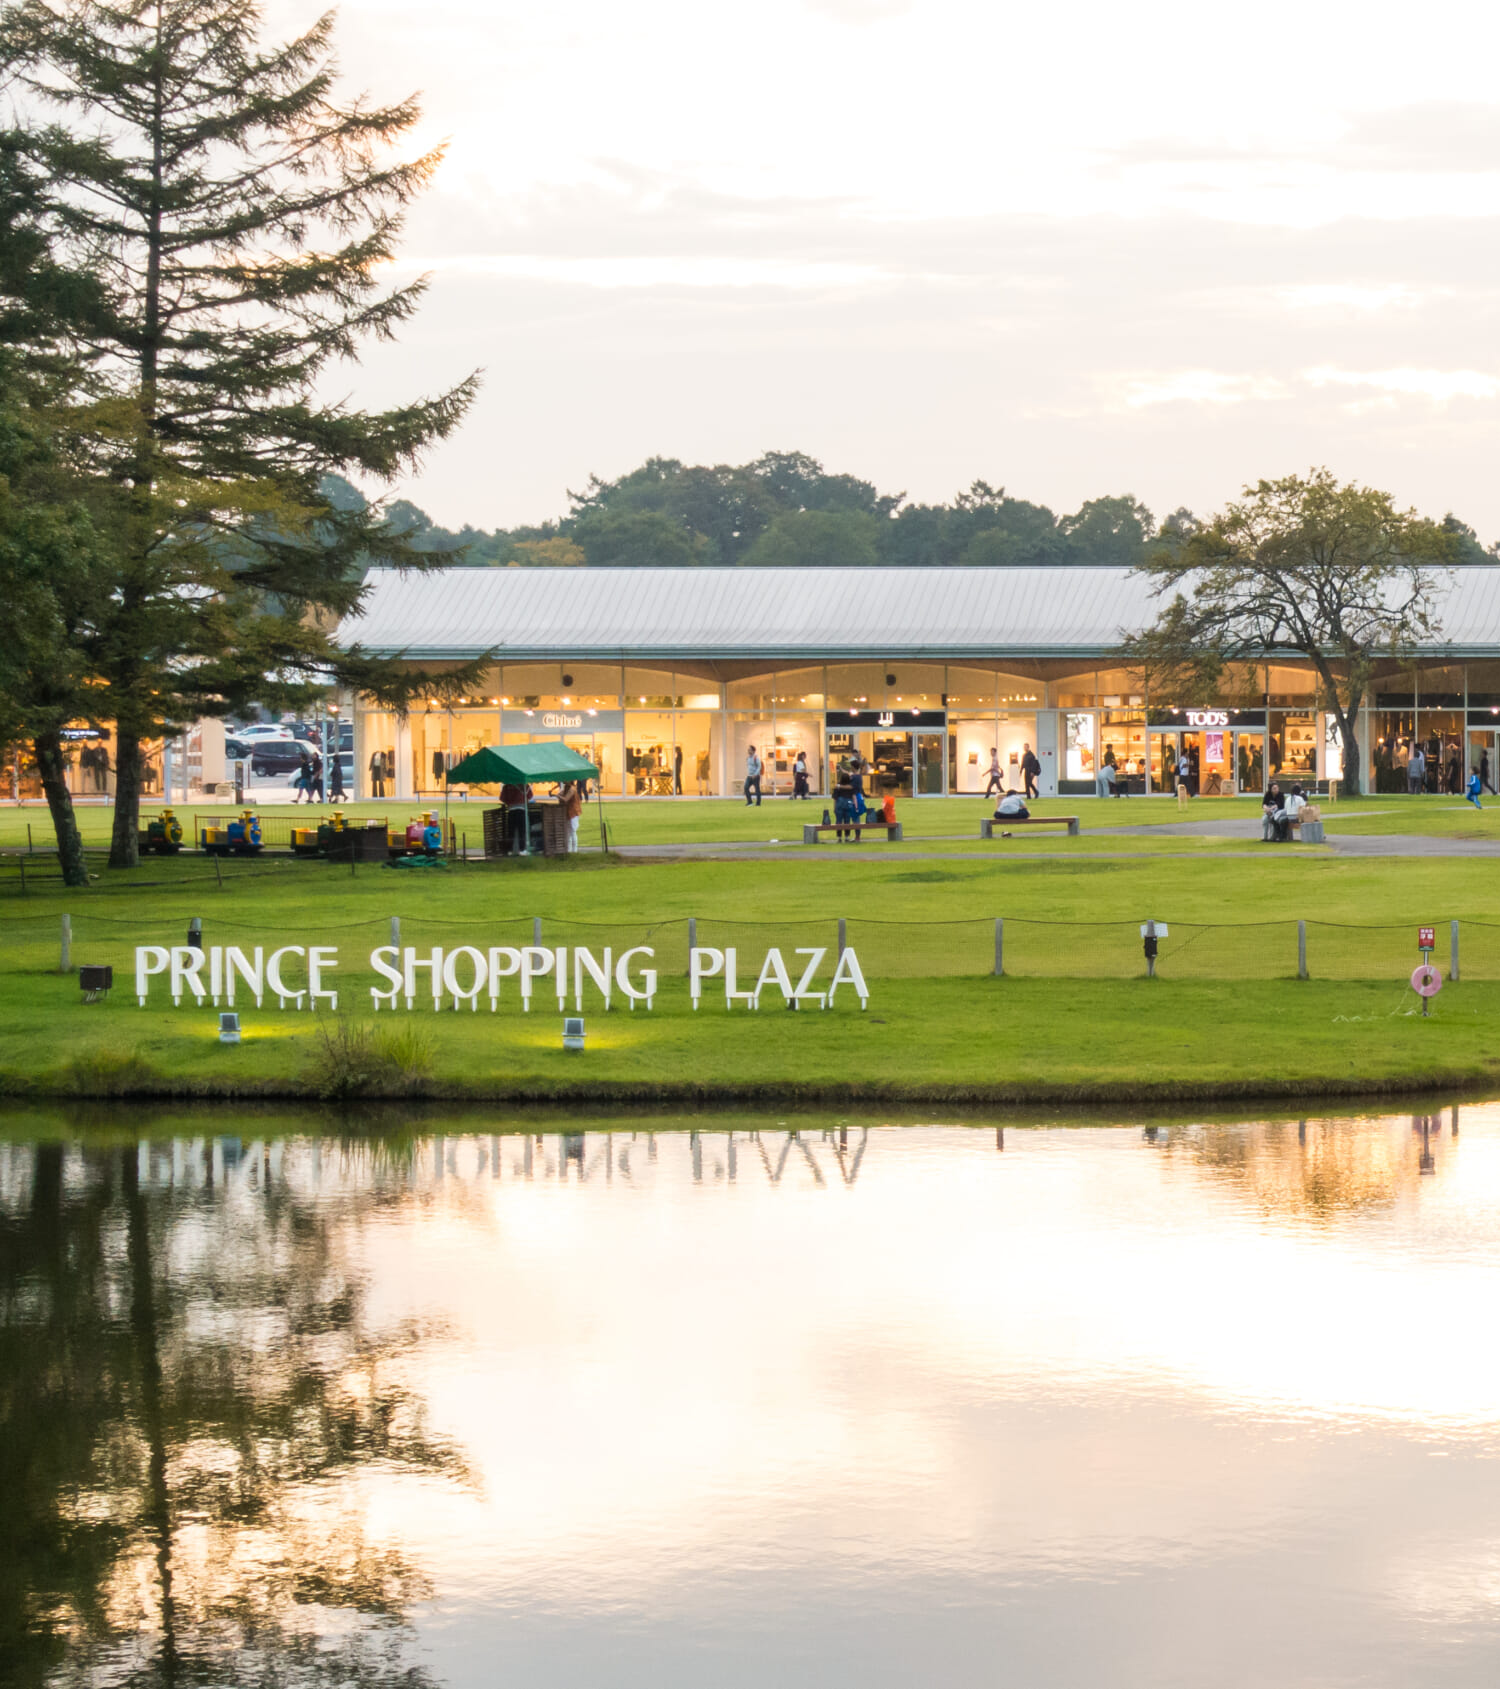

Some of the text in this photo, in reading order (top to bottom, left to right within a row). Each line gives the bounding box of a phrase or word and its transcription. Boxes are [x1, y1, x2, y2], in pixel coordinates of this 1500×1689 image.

[1186, 711, 1229, 726] TOD'S
[134, 946, 870, 999] PRINCE SHOPPING PLAZA
